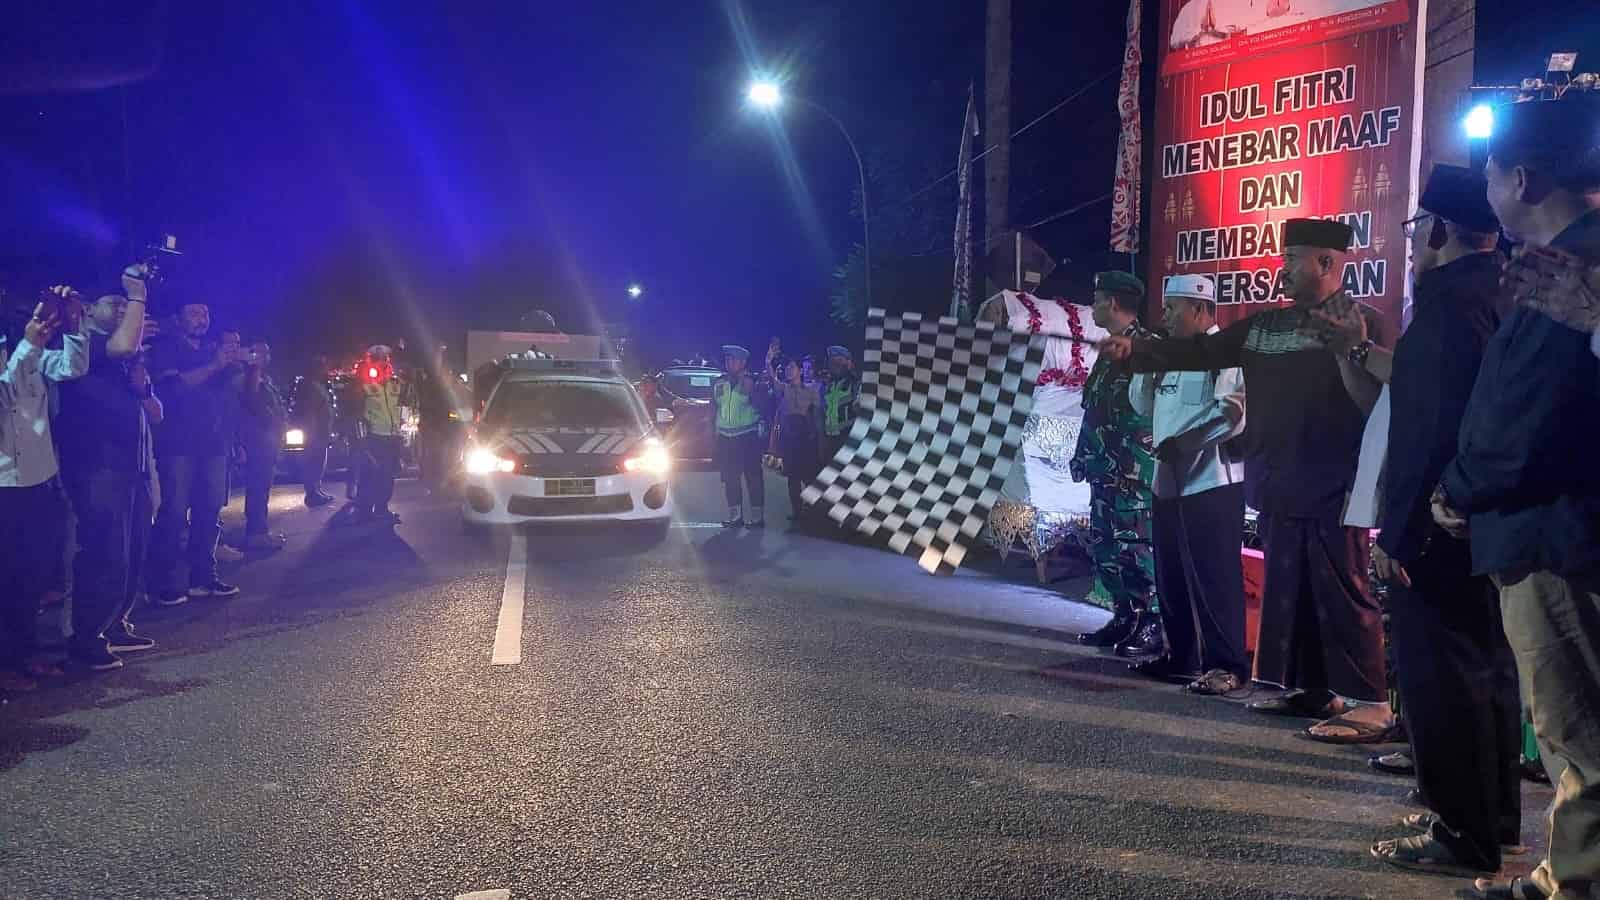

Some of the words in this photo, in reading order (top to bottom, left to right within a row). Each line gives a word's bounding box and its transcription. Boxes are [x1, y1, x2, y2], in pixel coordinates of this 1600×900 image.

[1201, 85, 1266, 128] IDUL
[1275, 65, 1355, 114] FITRI
[1163, 125, 1299, 178] MENEBAR
[1307, 107, 1400, 156] MAAF
[1240, 171, 1302, 213] DAN
[1177, 211, 1371, 264] MEMBAN
[1163, 260, 1386, 308] ERSAAN
